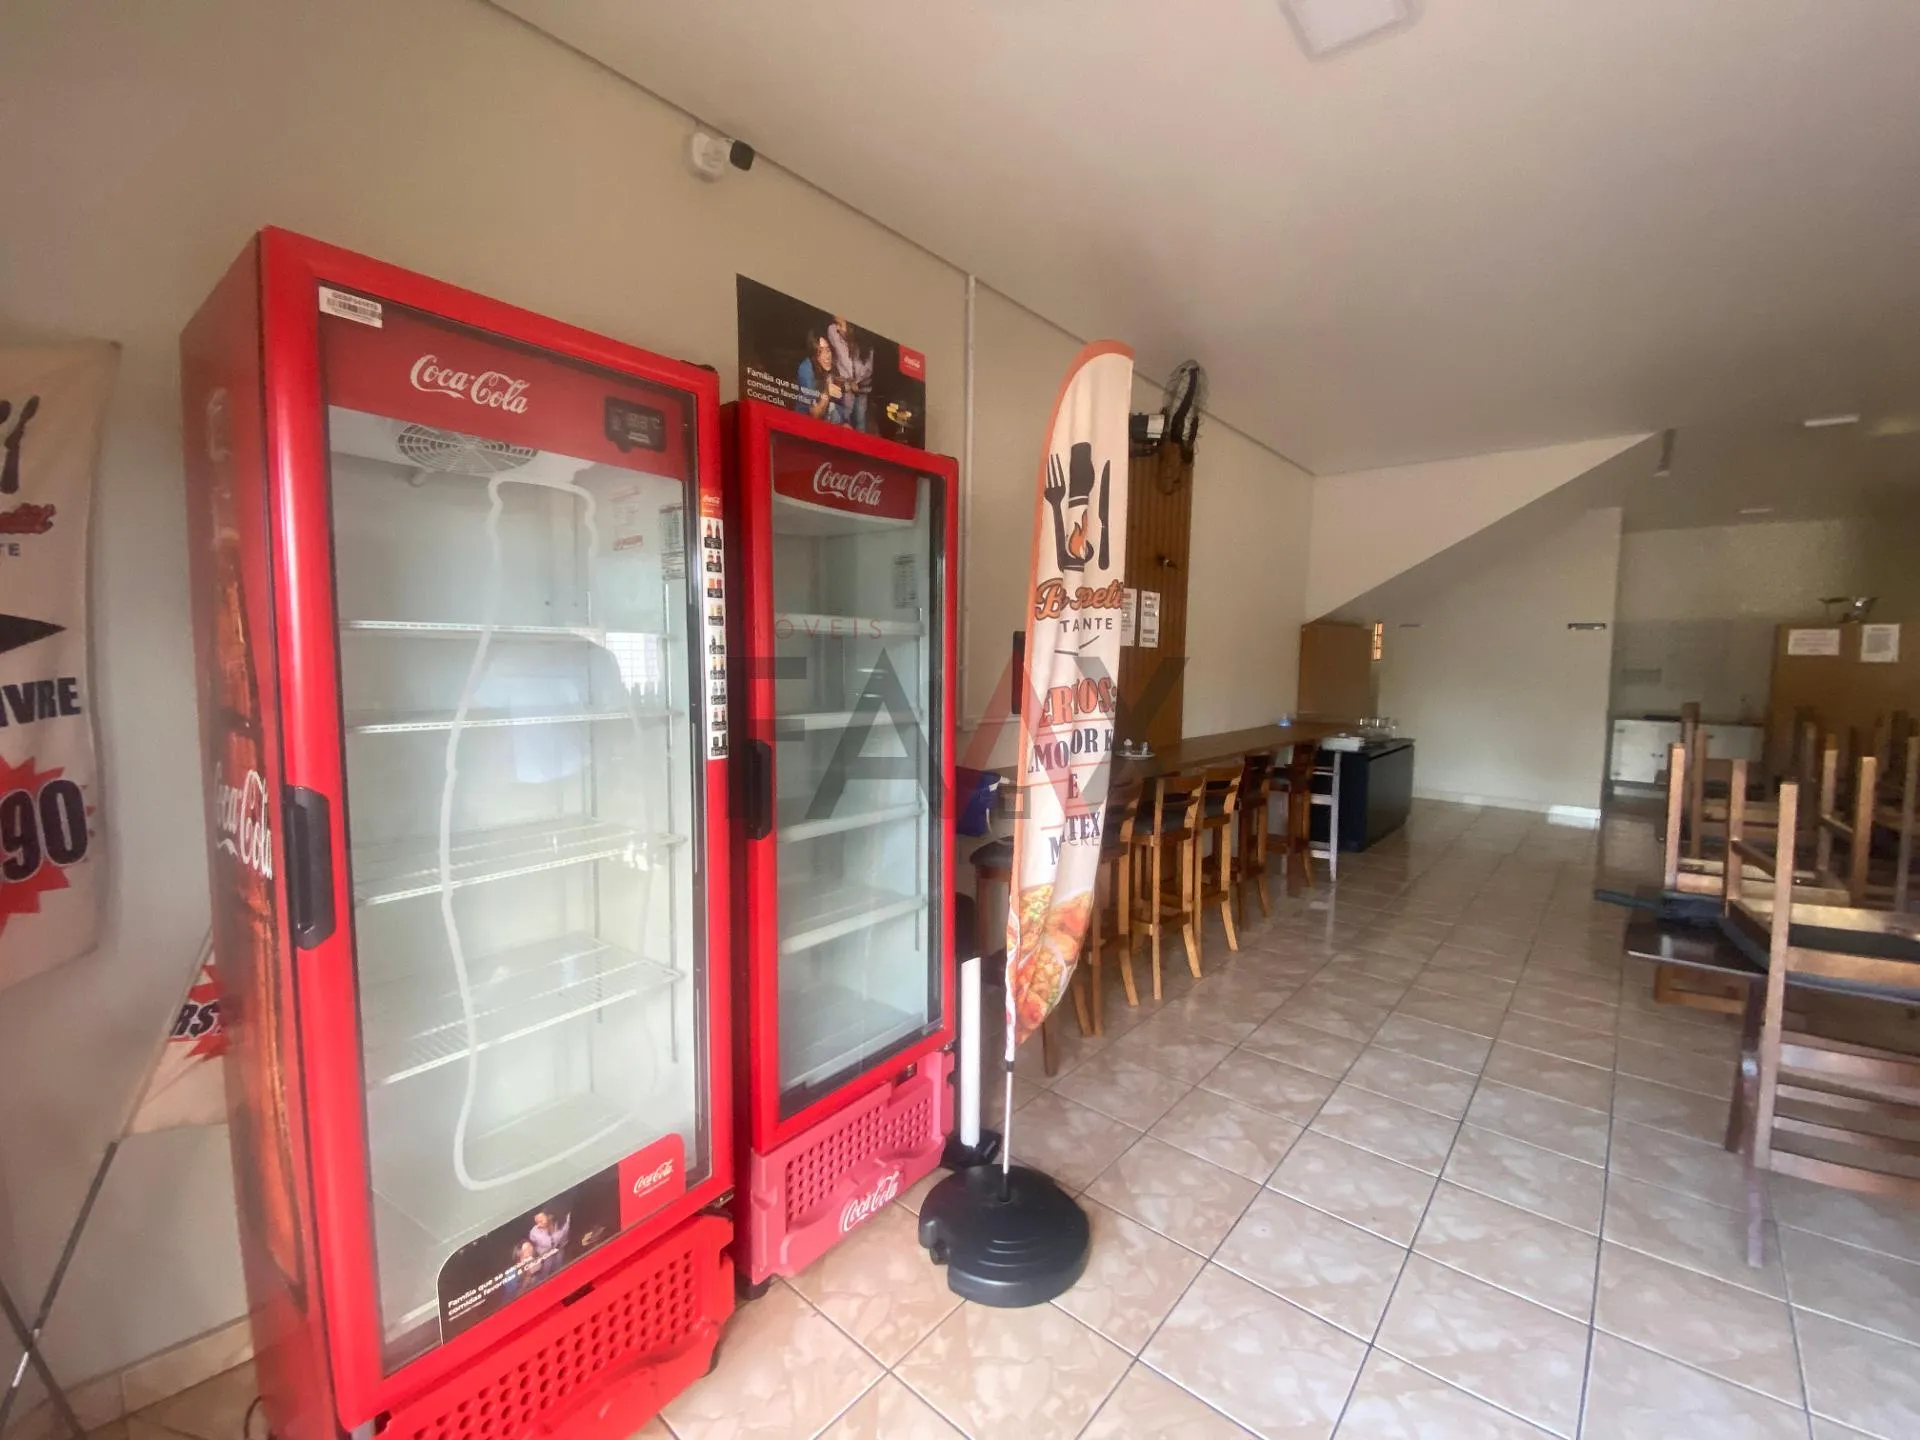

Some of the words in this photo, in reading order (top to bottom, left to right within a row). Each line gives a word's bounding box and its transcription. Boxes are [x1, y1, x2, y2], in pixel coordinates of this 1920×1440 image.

[410, 355, 531, 414] Coca-Cola
[813, 462, 885, 506] Coca-Cola
[841, 1170, 901, 1233] Coca-Cola
